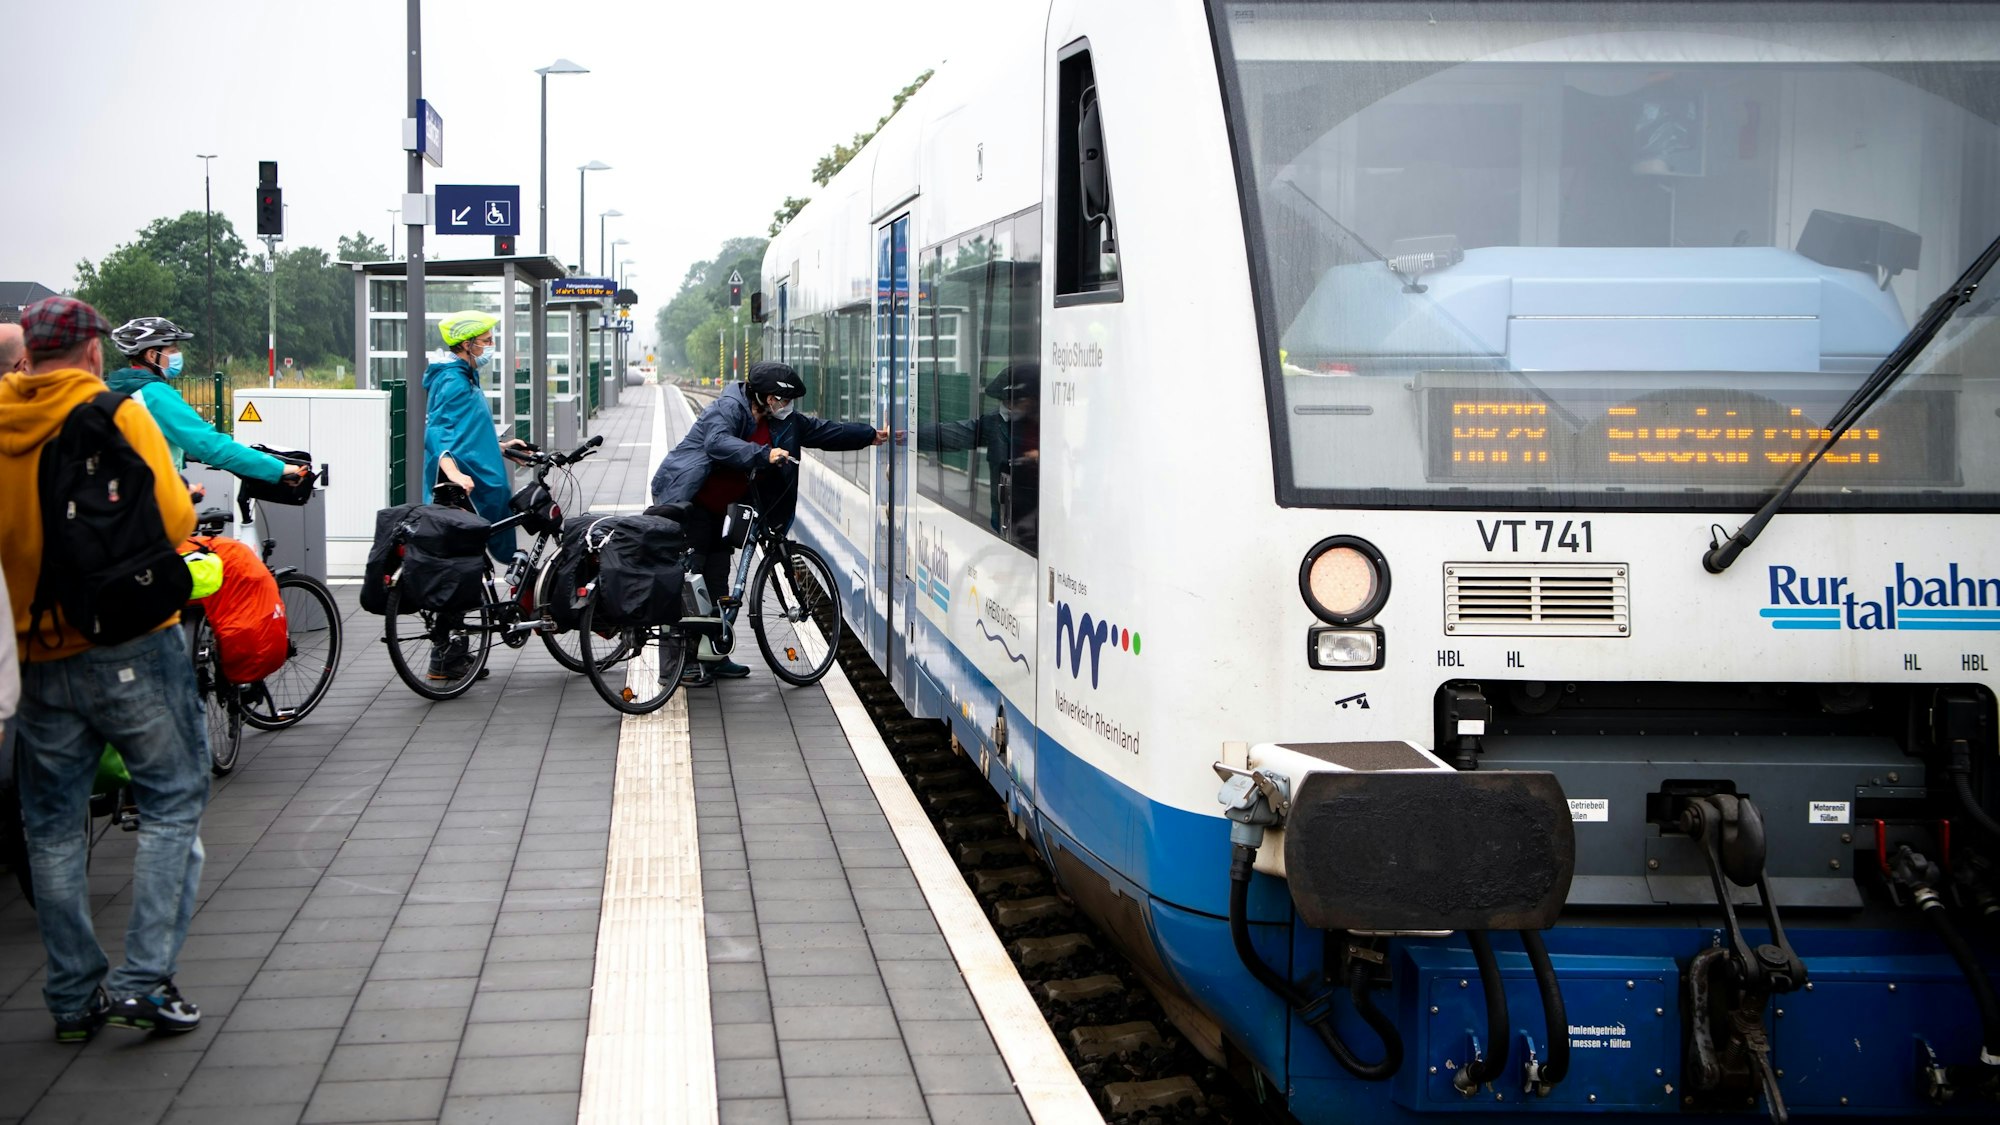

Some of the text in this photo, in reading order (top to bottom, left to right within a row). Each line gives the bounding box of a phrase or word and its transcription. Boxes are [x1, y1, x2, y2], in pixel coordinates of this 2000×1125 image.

[1052, 341, 1103, 373] RegioShuttle
[1051, 381, 1075, 406] VT 741
[1476, 519, 1592, 553] VT 741
[1078, 580, 1087, 596] des
[1001, 607, 1020, 640] DÜREN
[1437, 650, 1465, 667] HBL
[1507, 651, 1525, 668] HL
[1904, 653, 1922, 670] HL
[1962, 654, 1989, 671] HBL
[1055, 689, 1140, 755] Nahverkehr Rheinland
[1570, 800, 1605, 810] Getriebeöl
[1813, 803, 1846, 812] Motorenöl
[1571, 811, 1588, 820] üllen
[1820, 813, 1838, 822] füllen
[1567, 1025, 1626, 1036] Umlenkgetriebe
[1572, 1039, 1601, 1048] messen
[1609, 1038, 1631, 1049] füllen
